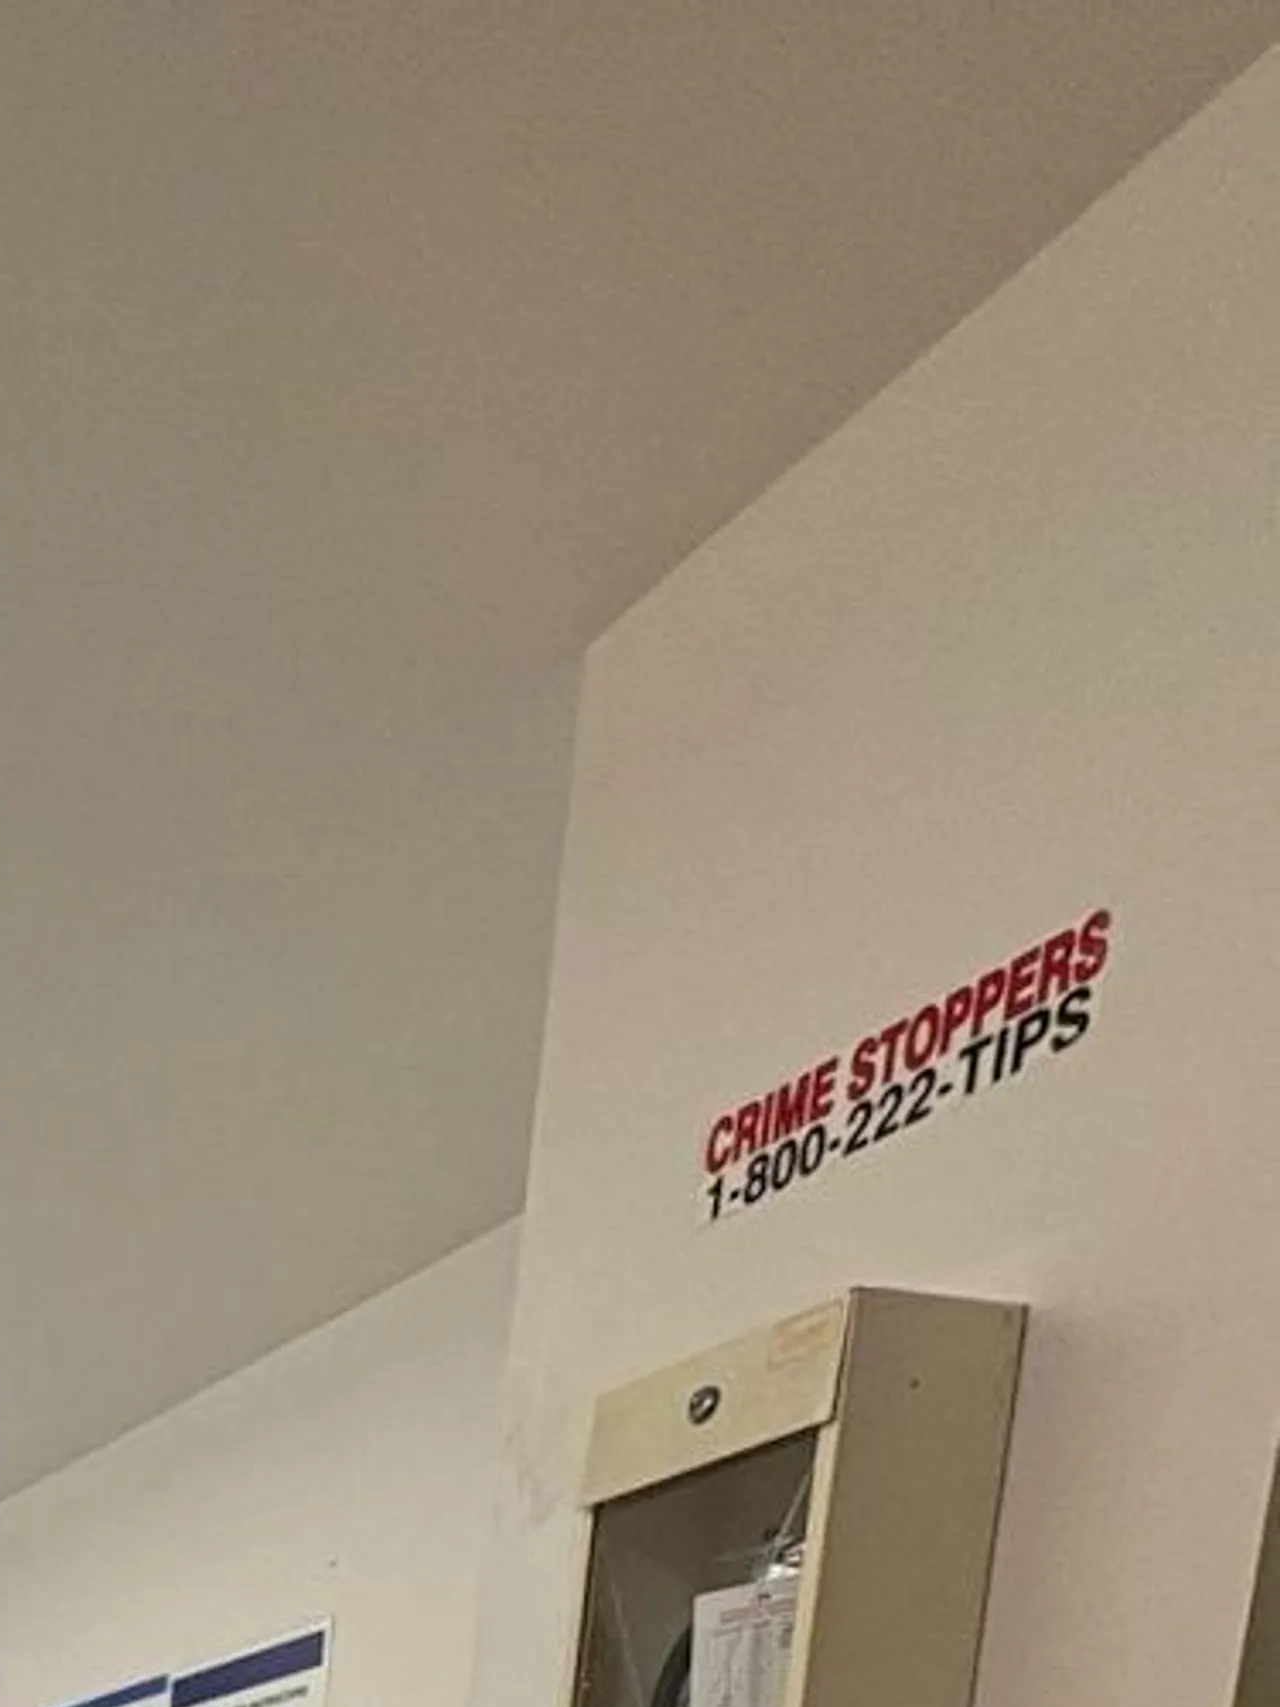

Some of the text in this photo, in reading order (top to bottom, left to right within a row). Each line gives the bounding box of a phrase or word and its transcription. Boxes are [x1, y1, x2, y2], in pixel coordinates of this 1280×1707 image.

[705, 909, 1111, 1175] CRIME STOPPERS
[706, 986, 1092, 1220] 1-800-222-TIPS
